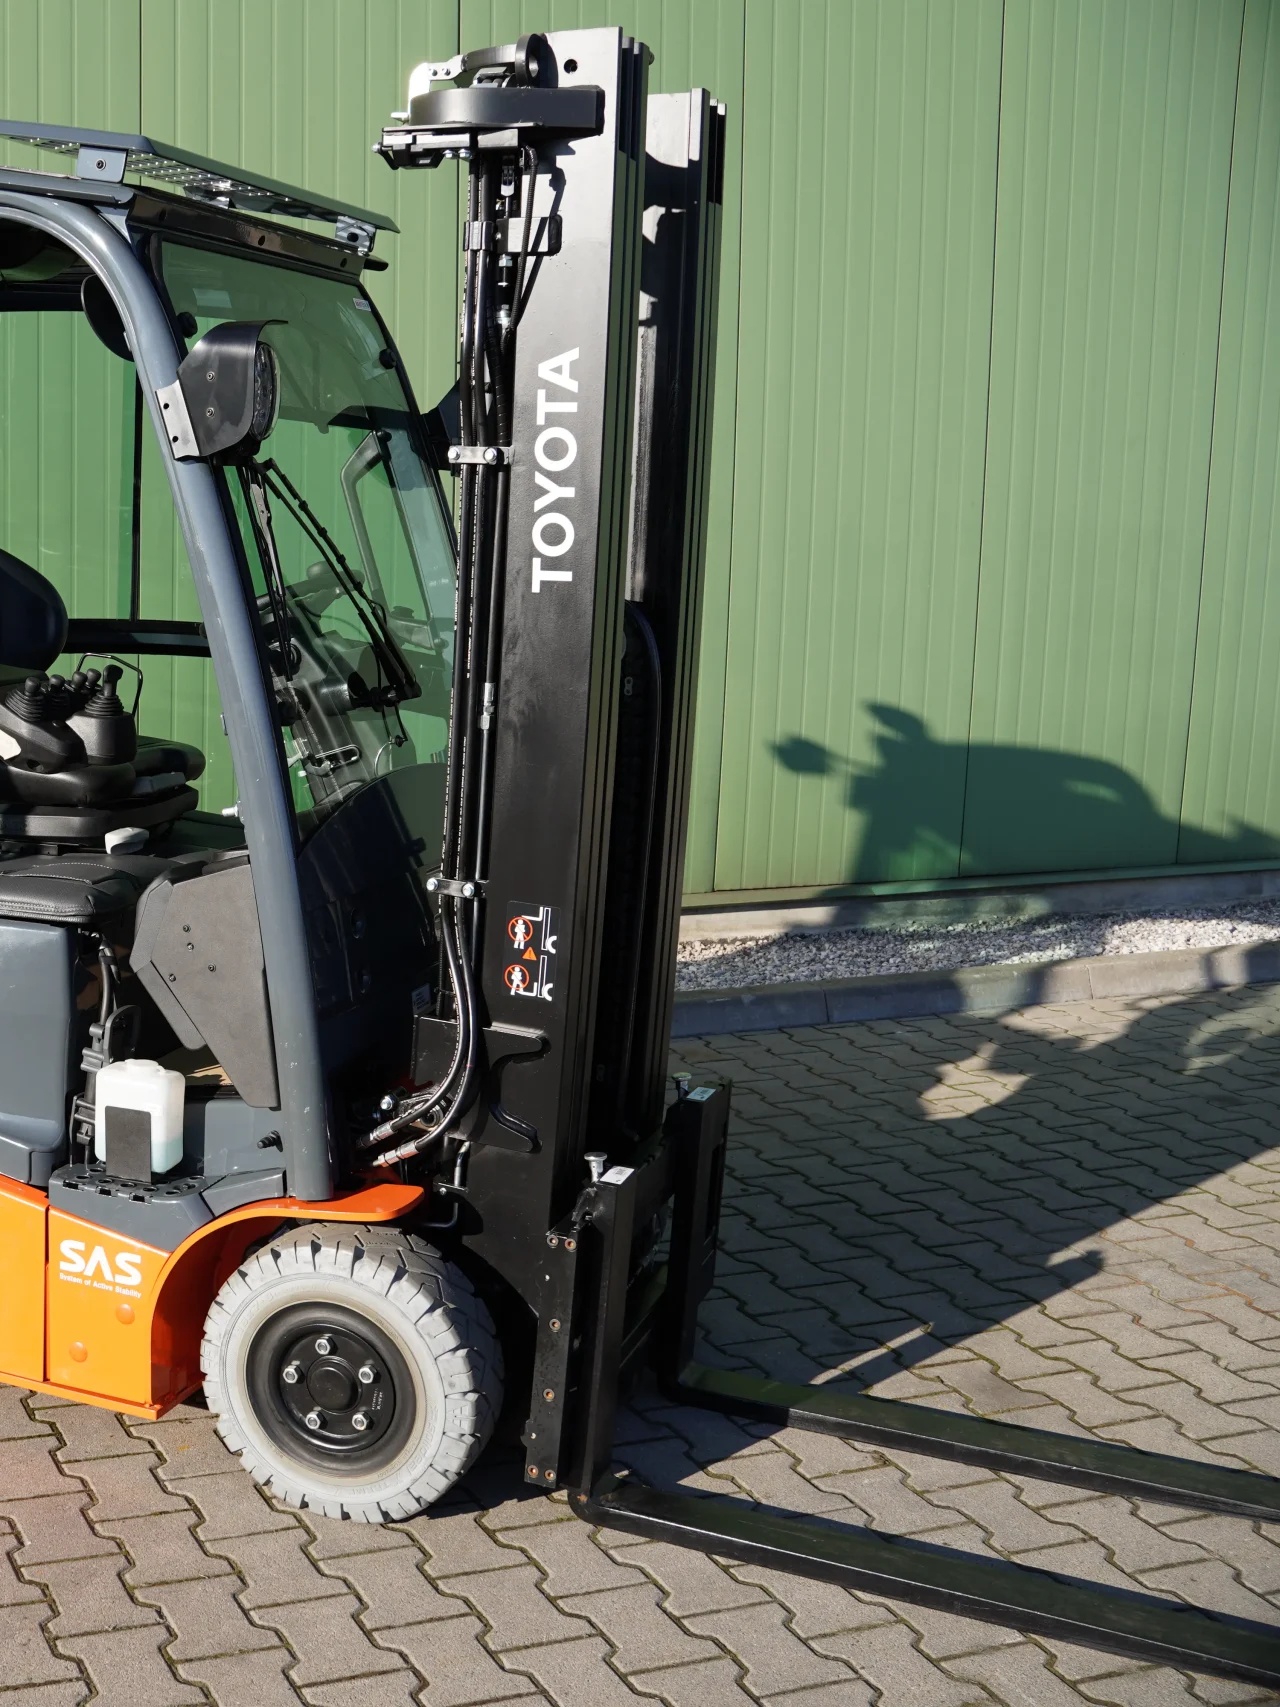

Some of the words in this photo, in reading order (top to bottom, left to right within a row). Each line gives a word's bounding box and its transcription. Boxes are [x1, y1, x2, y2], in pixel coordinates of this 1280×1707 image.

[530, 346, 580, 593] TOYOTA
[59, 1239, 142, 1286] SAS
[59, 1272, 83, 1285] System
[93, 1282, 113, 1292] Active
[115, 1286, 142, 1299] Stability
